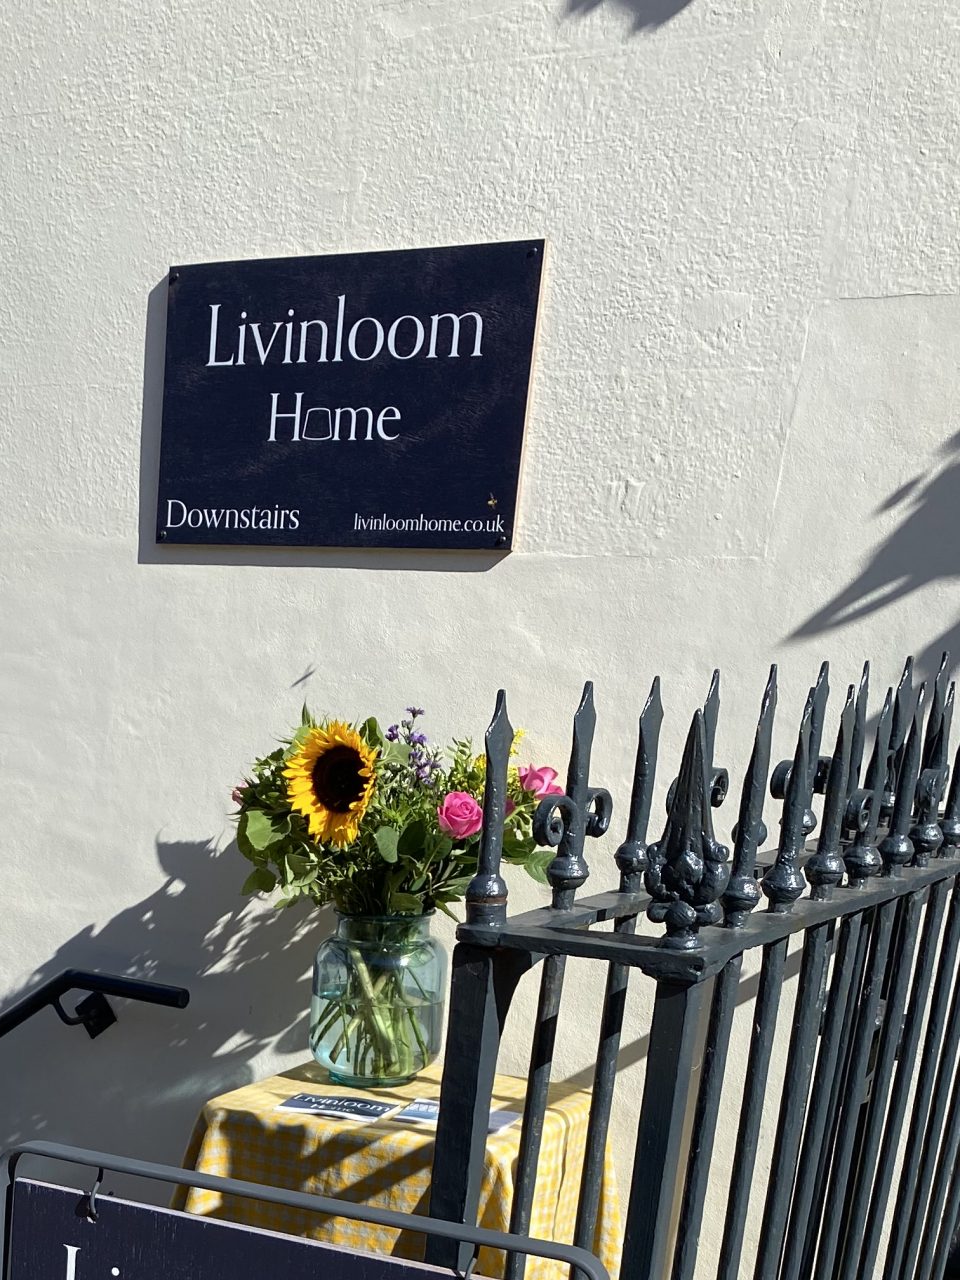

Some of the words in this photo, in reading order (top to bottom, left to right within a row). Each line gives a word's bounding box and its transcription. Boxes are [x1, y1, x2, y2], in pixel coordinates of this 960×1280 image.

[205, 294, 483, 367] Livinloom
[165, 499, 300, 530] Downstairs
[353, 512, 505, 534] livinloomhome.co.uk
[293, 1093, 392, 1113] Livinloom
